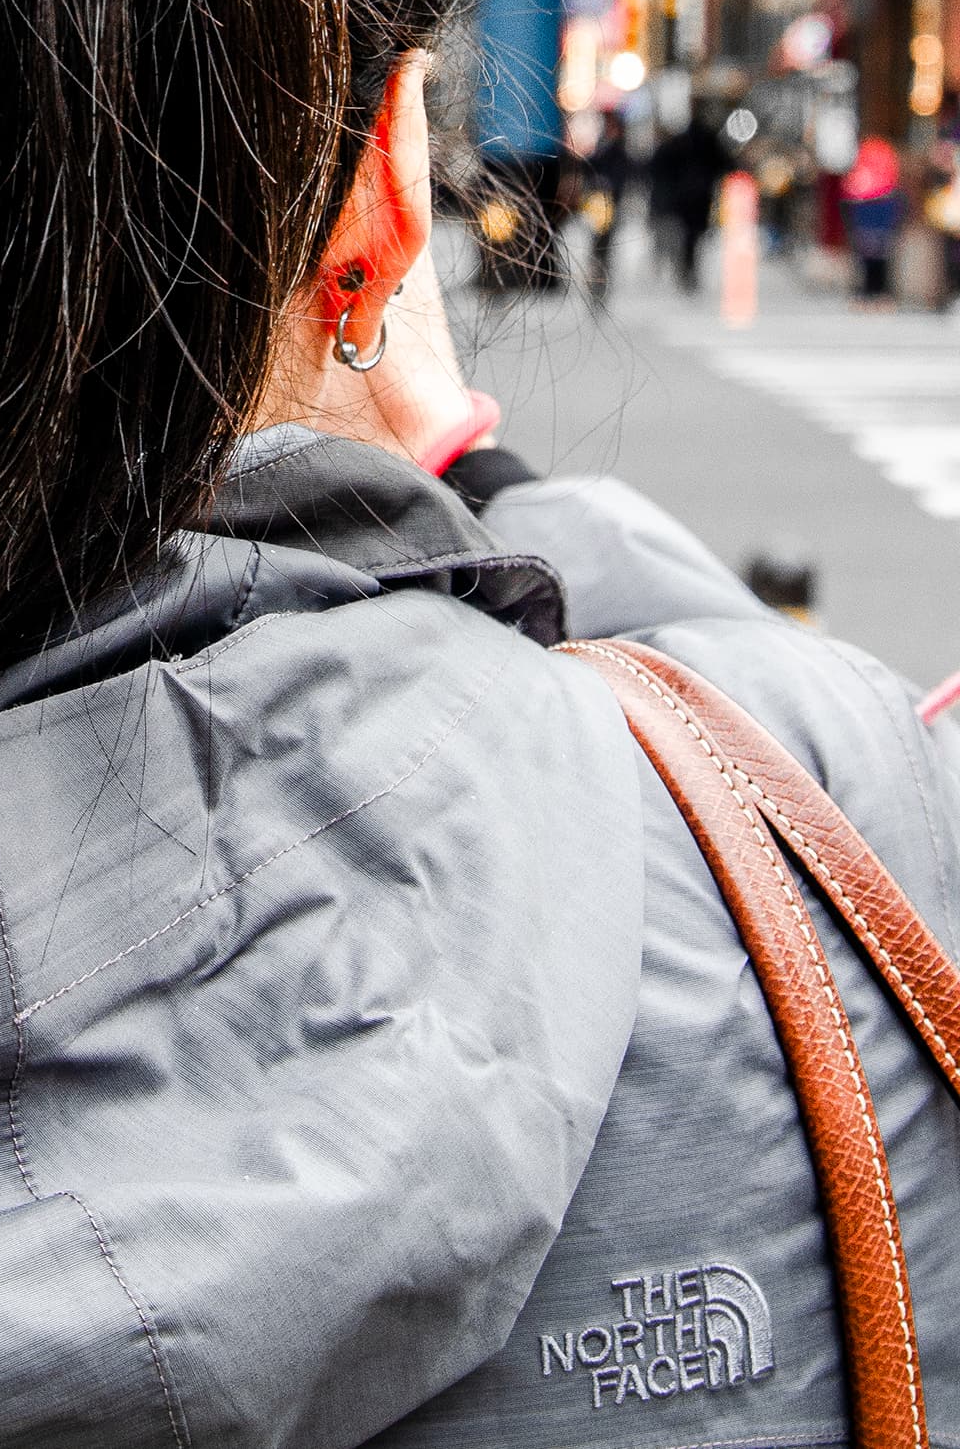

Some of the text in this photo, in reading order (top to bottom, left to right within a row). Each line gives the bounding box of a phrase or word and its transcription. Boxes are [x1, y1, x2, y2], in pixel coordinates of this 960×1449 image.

[611, 1268, 703, 1318] THE
[540, 1307, 703, 1375] NORTH
[592, 1350, 705, 1408] FACE
